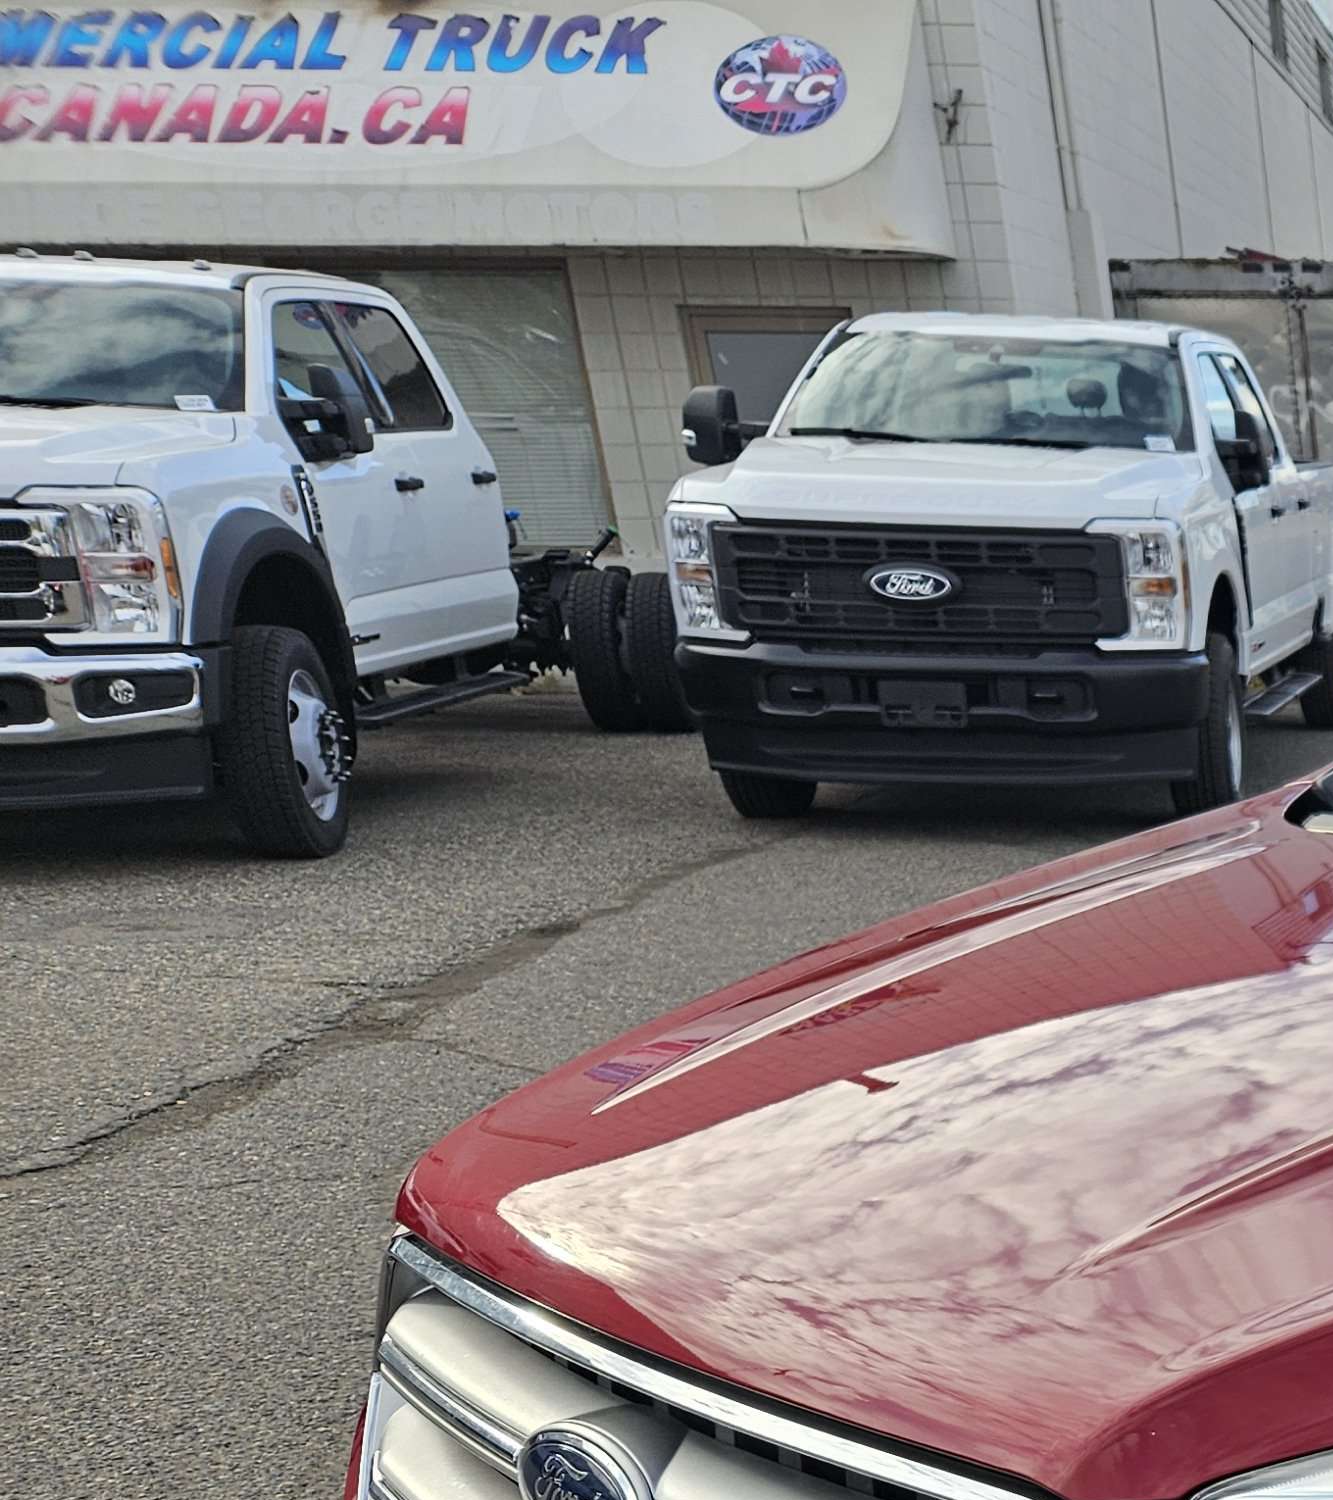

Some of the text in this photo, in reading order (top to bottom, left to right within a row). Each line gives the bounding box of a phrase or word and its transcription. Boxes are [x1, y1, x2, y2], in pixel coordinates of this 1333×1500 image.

[0, 10, 667, 74] MERCIAL TRUCK
[720, 72, 836, 104] CTC
[0, 83, 470, 145] CANADA.CA
[886, 574, 935, 594] Ford
